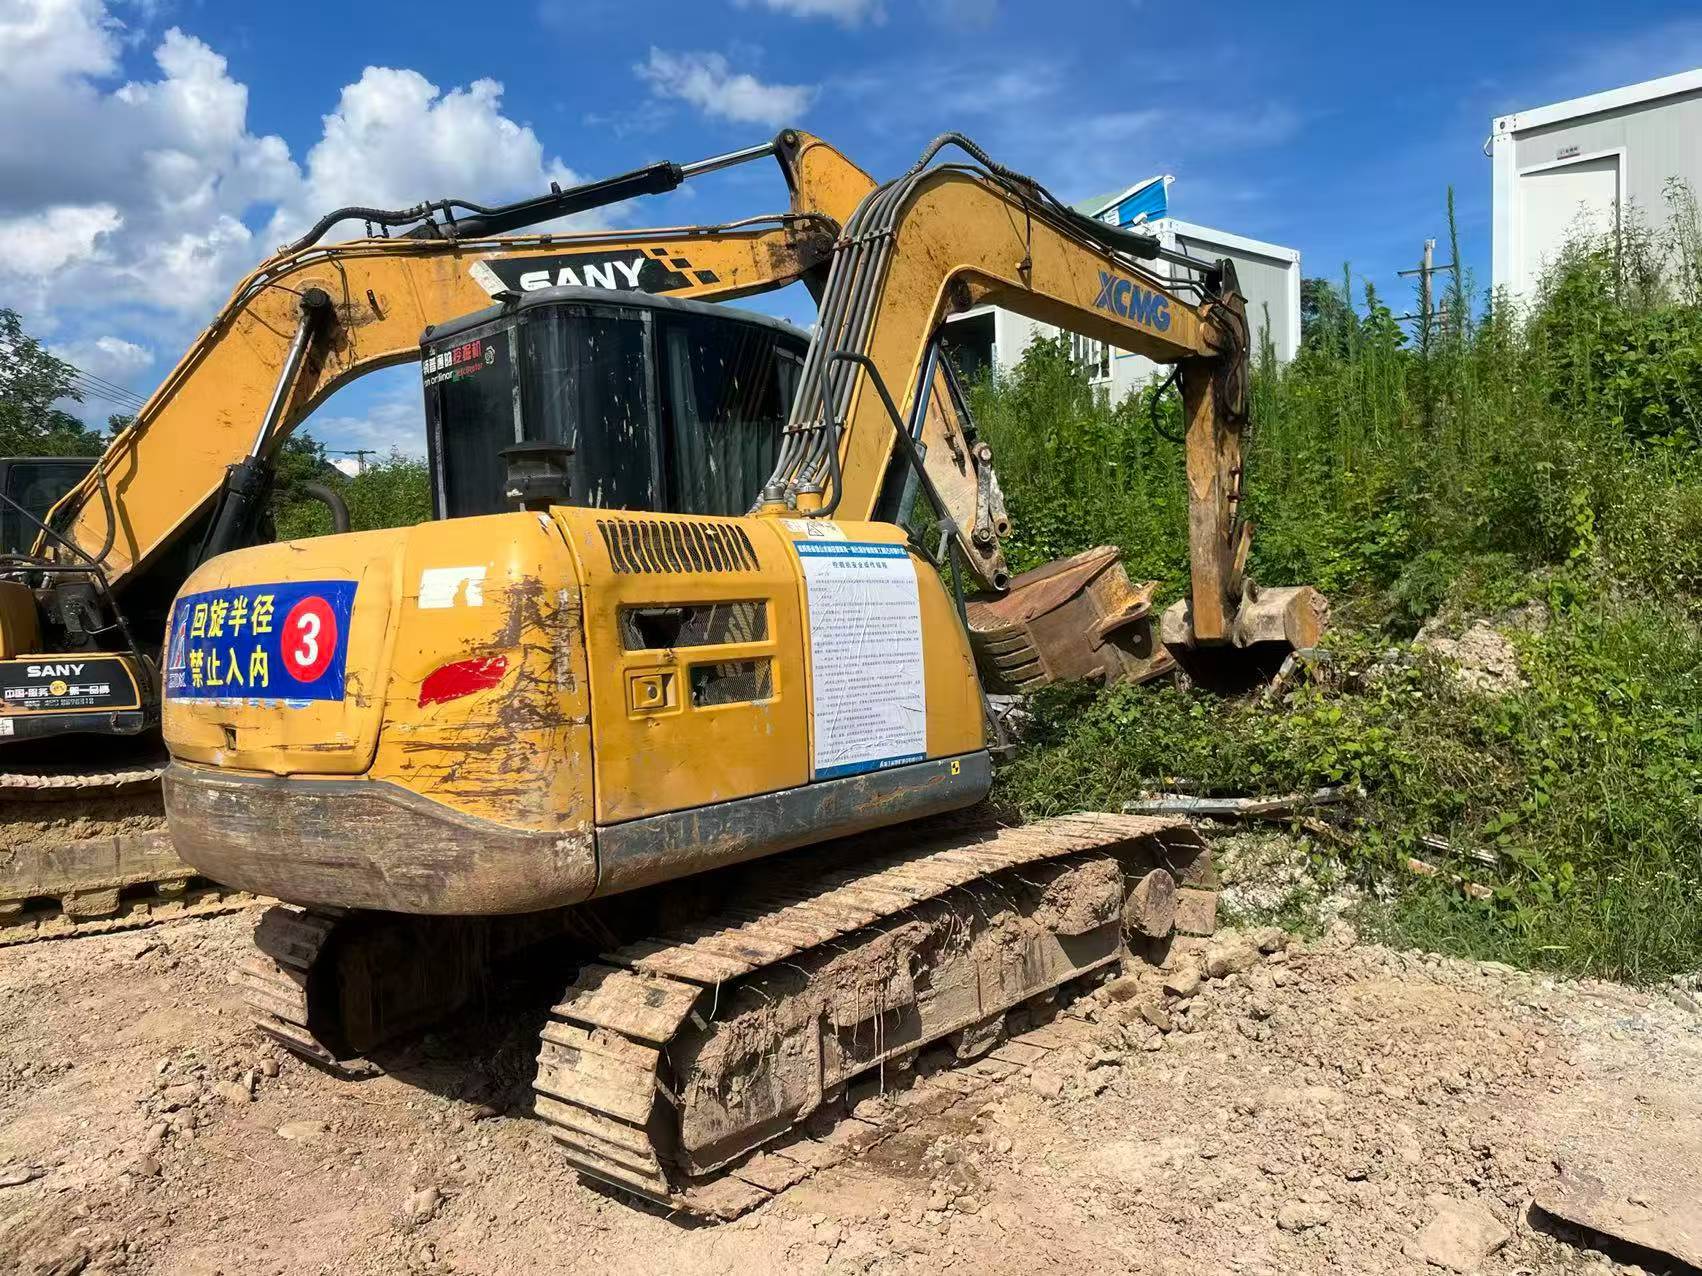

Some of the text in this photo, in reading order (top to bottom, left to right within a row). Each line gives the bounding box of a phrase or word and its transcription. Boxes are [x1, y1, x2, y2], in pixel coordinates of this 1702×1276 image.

[520, 257, 645, 291] SANY
[1093, 268, 1171, 332] XCMG
[190, 594, 275, 638] 回旋半径
[294, 613, 321, 666] 3
[27, 664, 85, 677] SANY
[190, 644, 270, 689] 禁止入内
